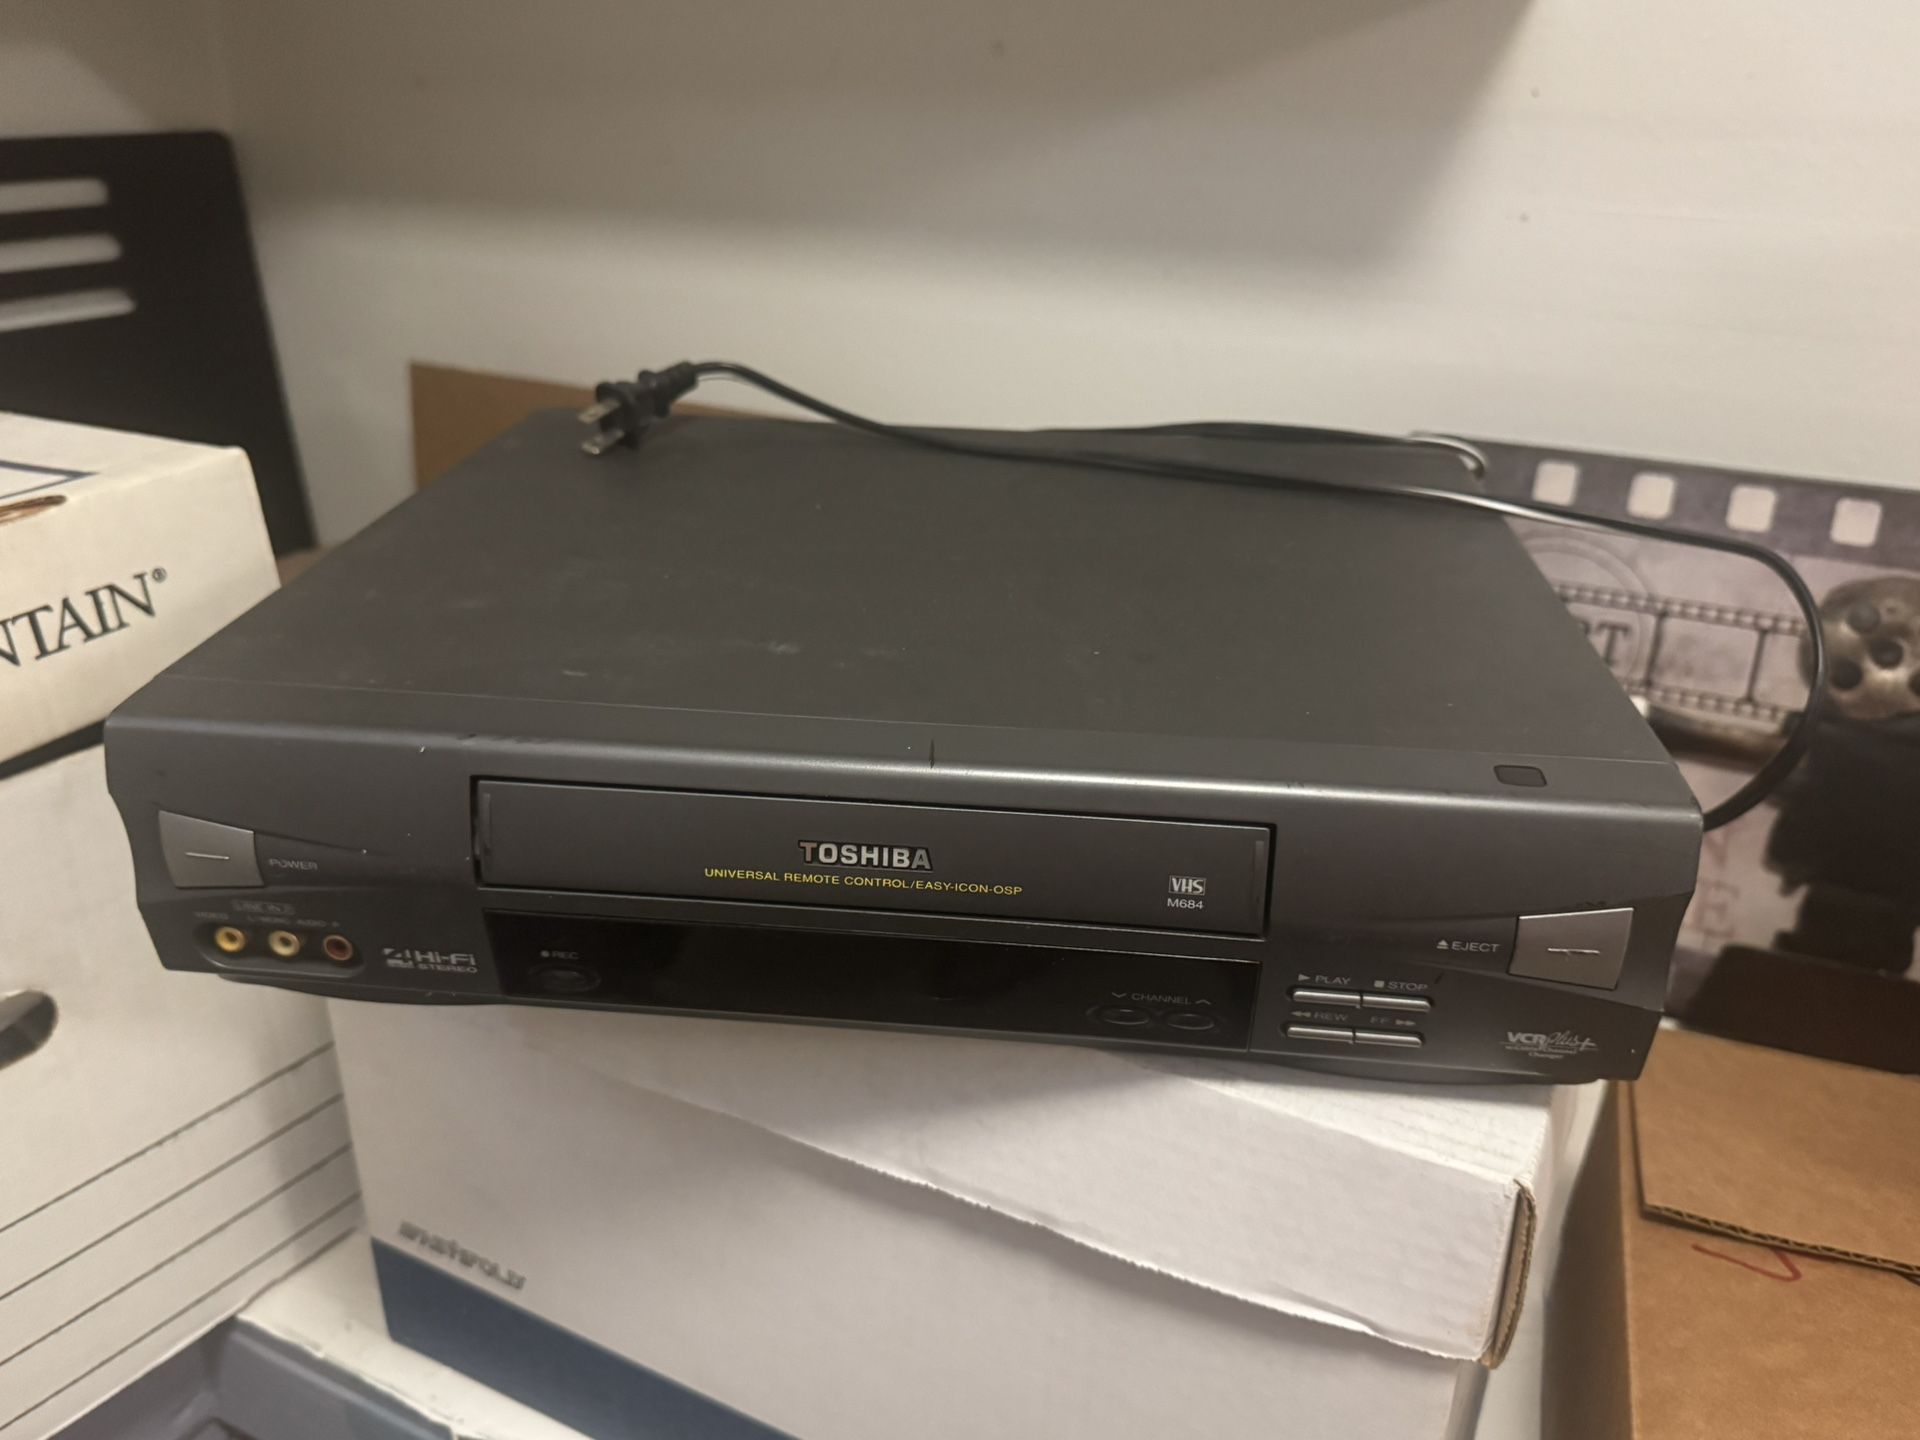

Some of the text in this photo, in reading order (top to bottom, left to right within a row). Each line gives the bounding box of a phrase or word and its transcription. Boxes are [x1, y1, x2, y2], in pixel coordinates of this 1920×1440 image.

[799, 841, 931, 870] TOSHIBA
[268, 858, 319, 870] POWER
[704, 867, 780, 881] UNIVERSAL
[784, 873, 840, 885] REMOTE
[1171, 877, 1204, 894] VHS
[1167, 898, 1203, 909] M684
[1451, 940, 1499, 953] EJECT
[415, 950, 476, 966] Hi-Fi
[551, 950, 579, 960] REC
[417, 963, 478, 974] STEREO
[1314, 974, 1351, 985] PLAY
[1387, 981, 1428, 991] STOP
[1131, 992, 1192, 1005] CHANNEL
[1313, 1011, 1349, 1021] REW
[1370, 1015, 1390, 1025] FF
[1506, 1031, 1547, 1047] VCR
